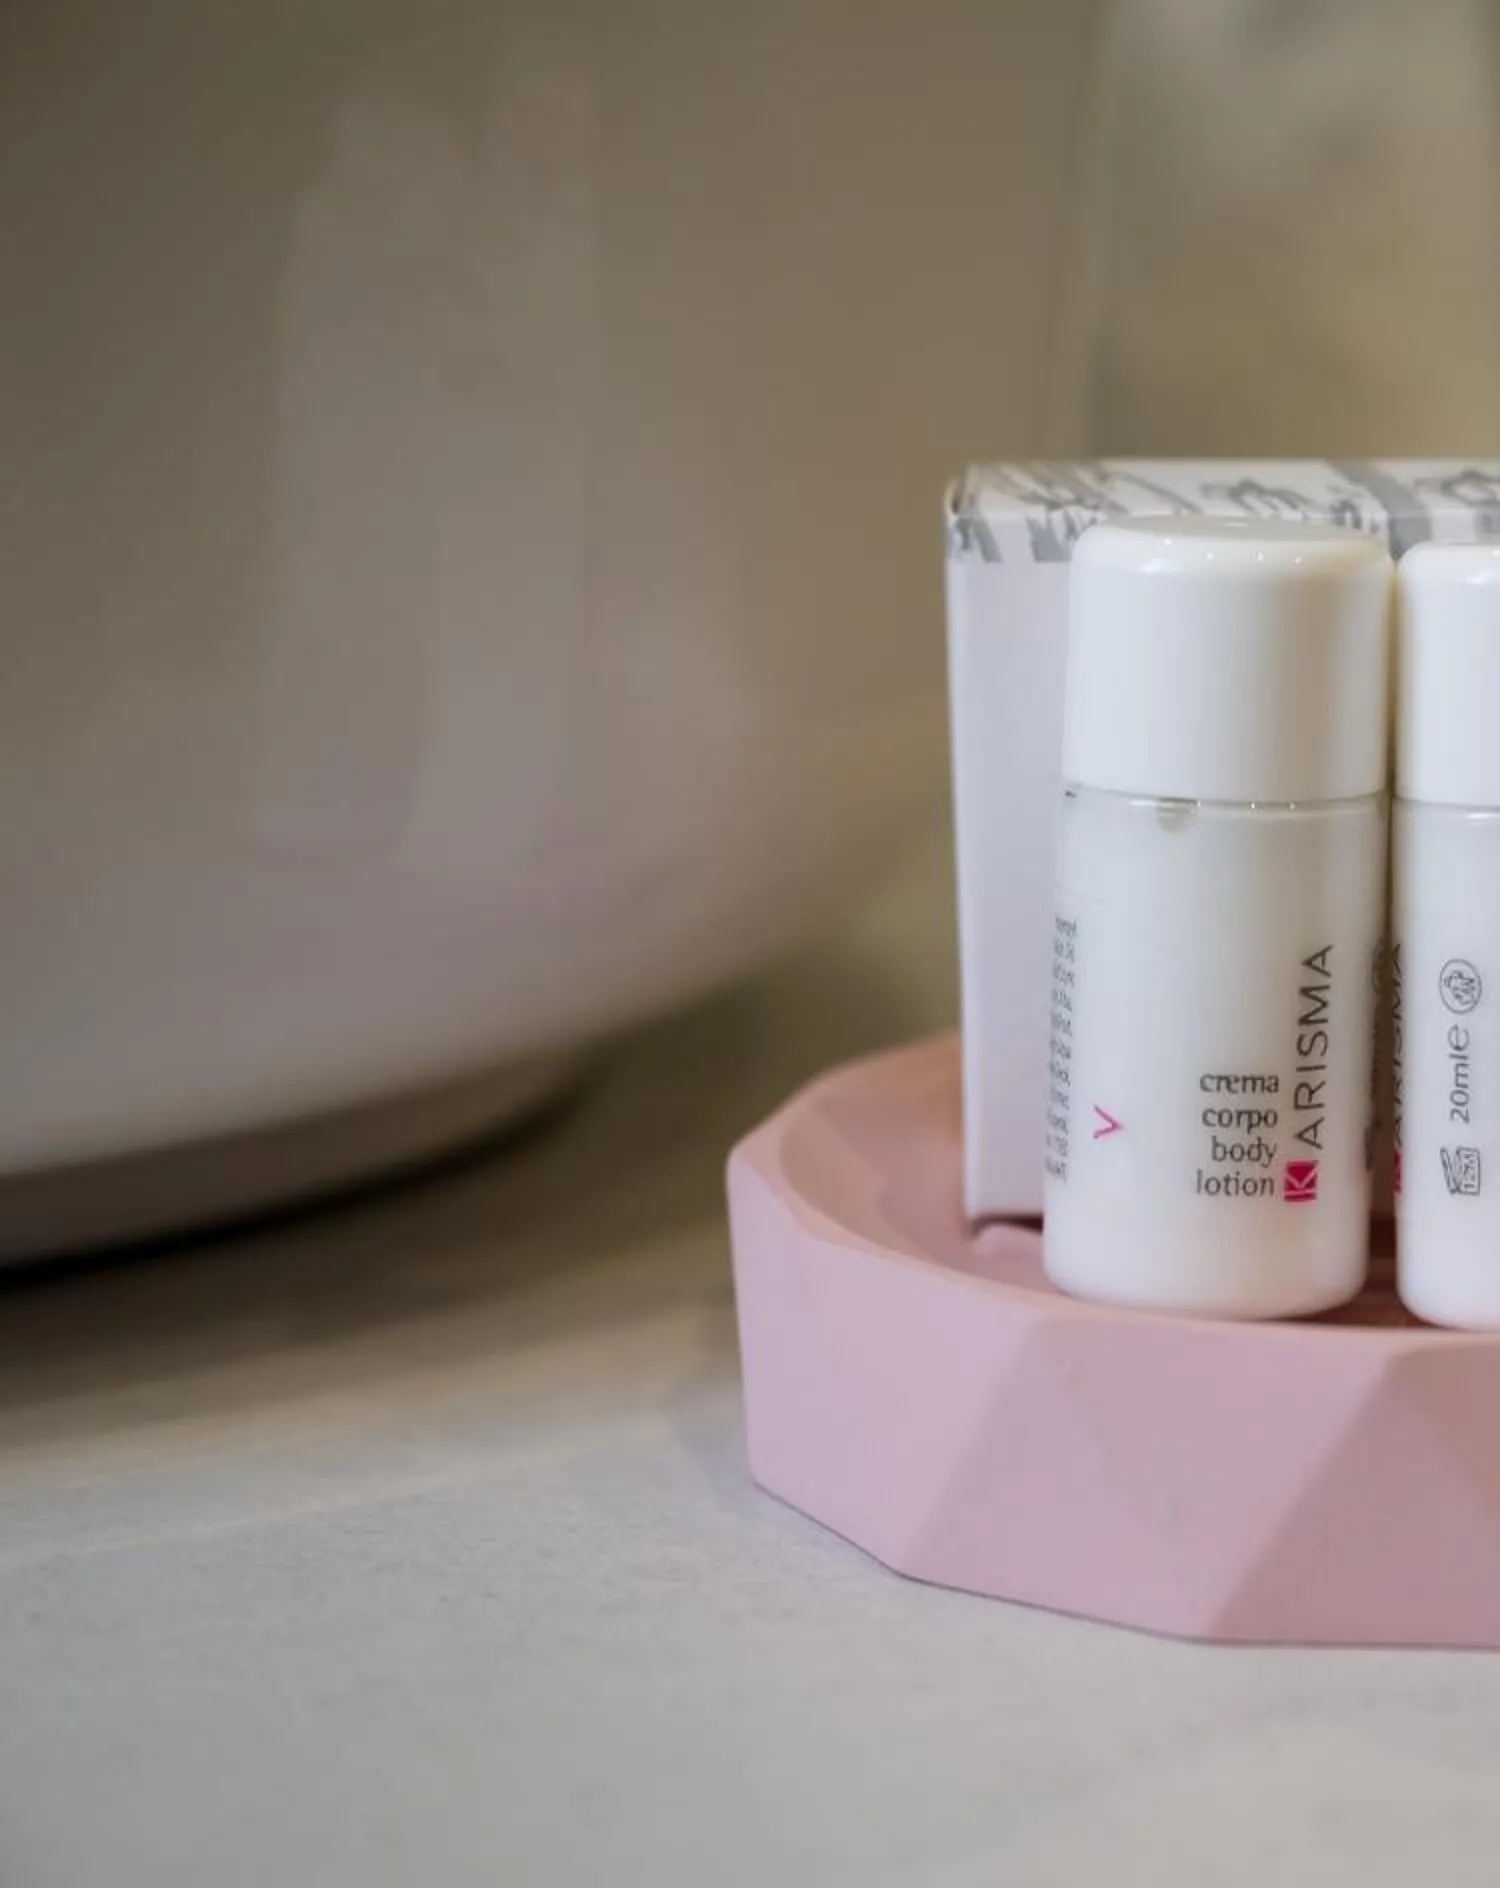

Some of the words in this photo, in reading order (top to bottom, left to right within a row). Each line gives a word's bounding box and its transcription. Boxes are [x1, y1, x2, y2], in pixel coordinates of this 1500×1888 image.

[1199, 1073, 1279, 1094] crema
[1283, 945, 1333, 1202] KARISMA
[1201, 1105, 1279, 1132] corpo
[1211, 1136, 1278, 1168] body
[1196, 1169, 1275, 1197] lotion
